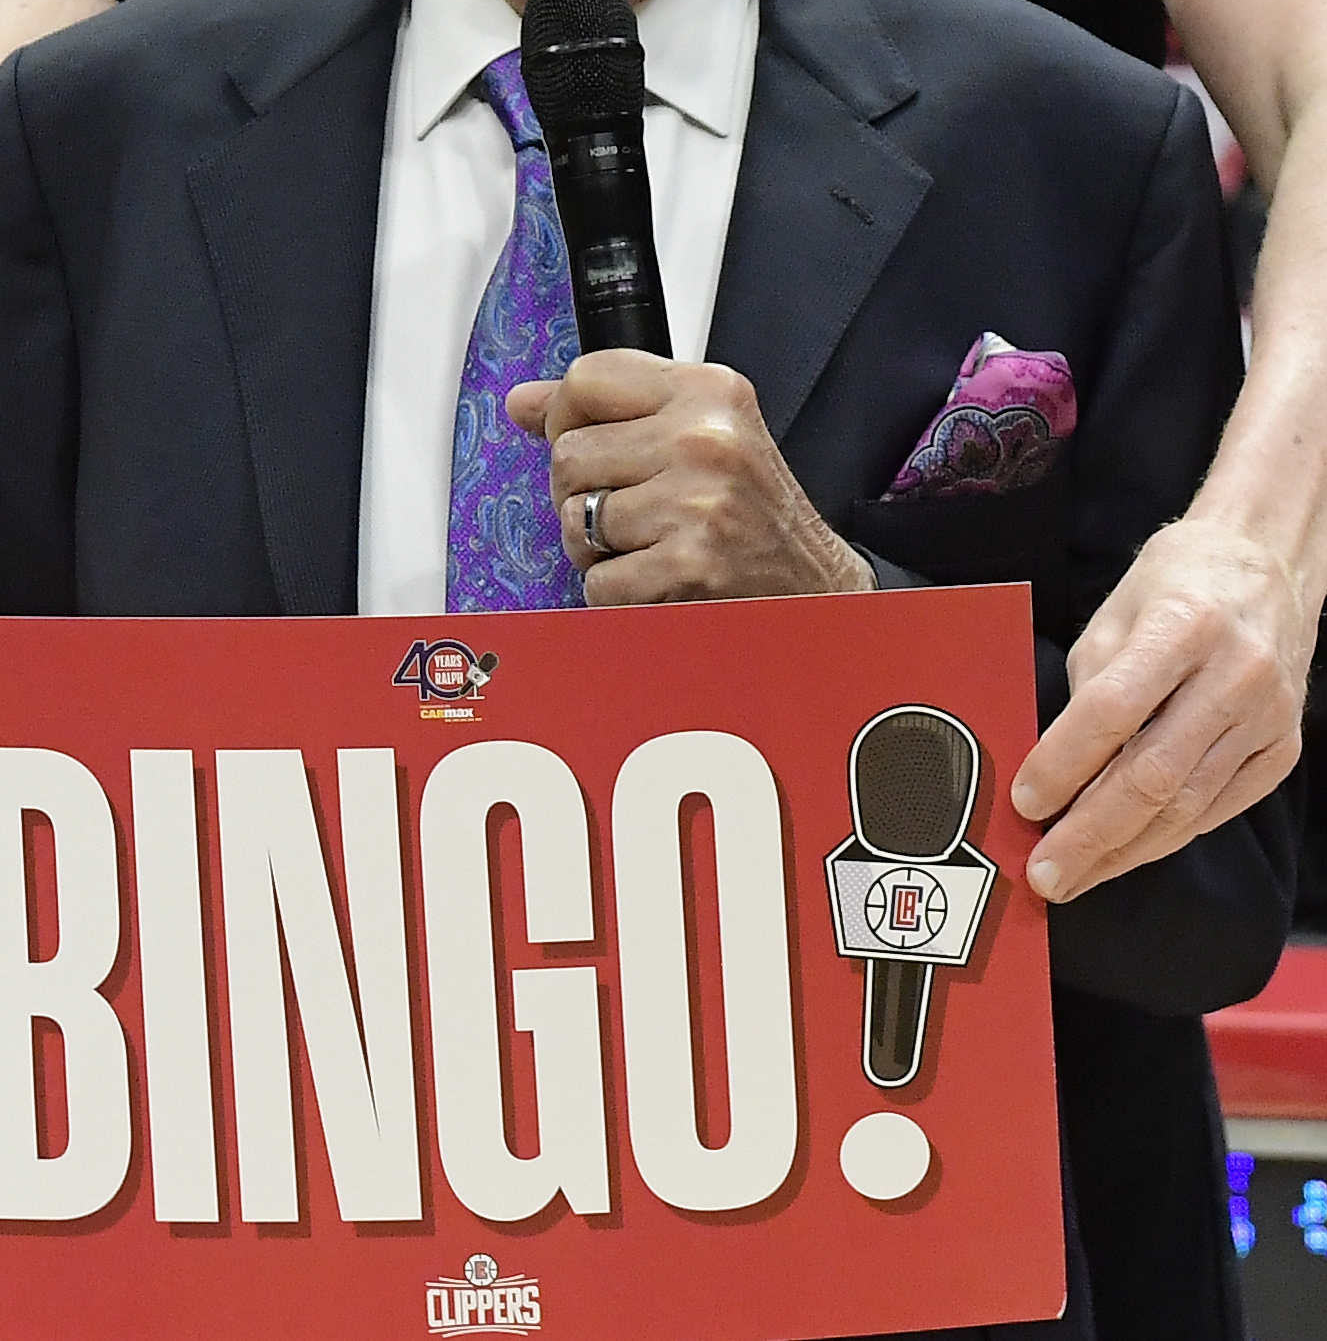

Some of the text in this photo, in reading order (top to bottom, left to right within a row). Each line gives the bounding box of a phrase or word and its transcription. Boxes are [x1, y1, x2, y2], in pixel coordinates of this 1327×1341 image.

[434, 654, 463, 668] YEARS
[434, 671, 464, 685] RALPH
[426, 1285, 542, 1328] CLIPPERS
